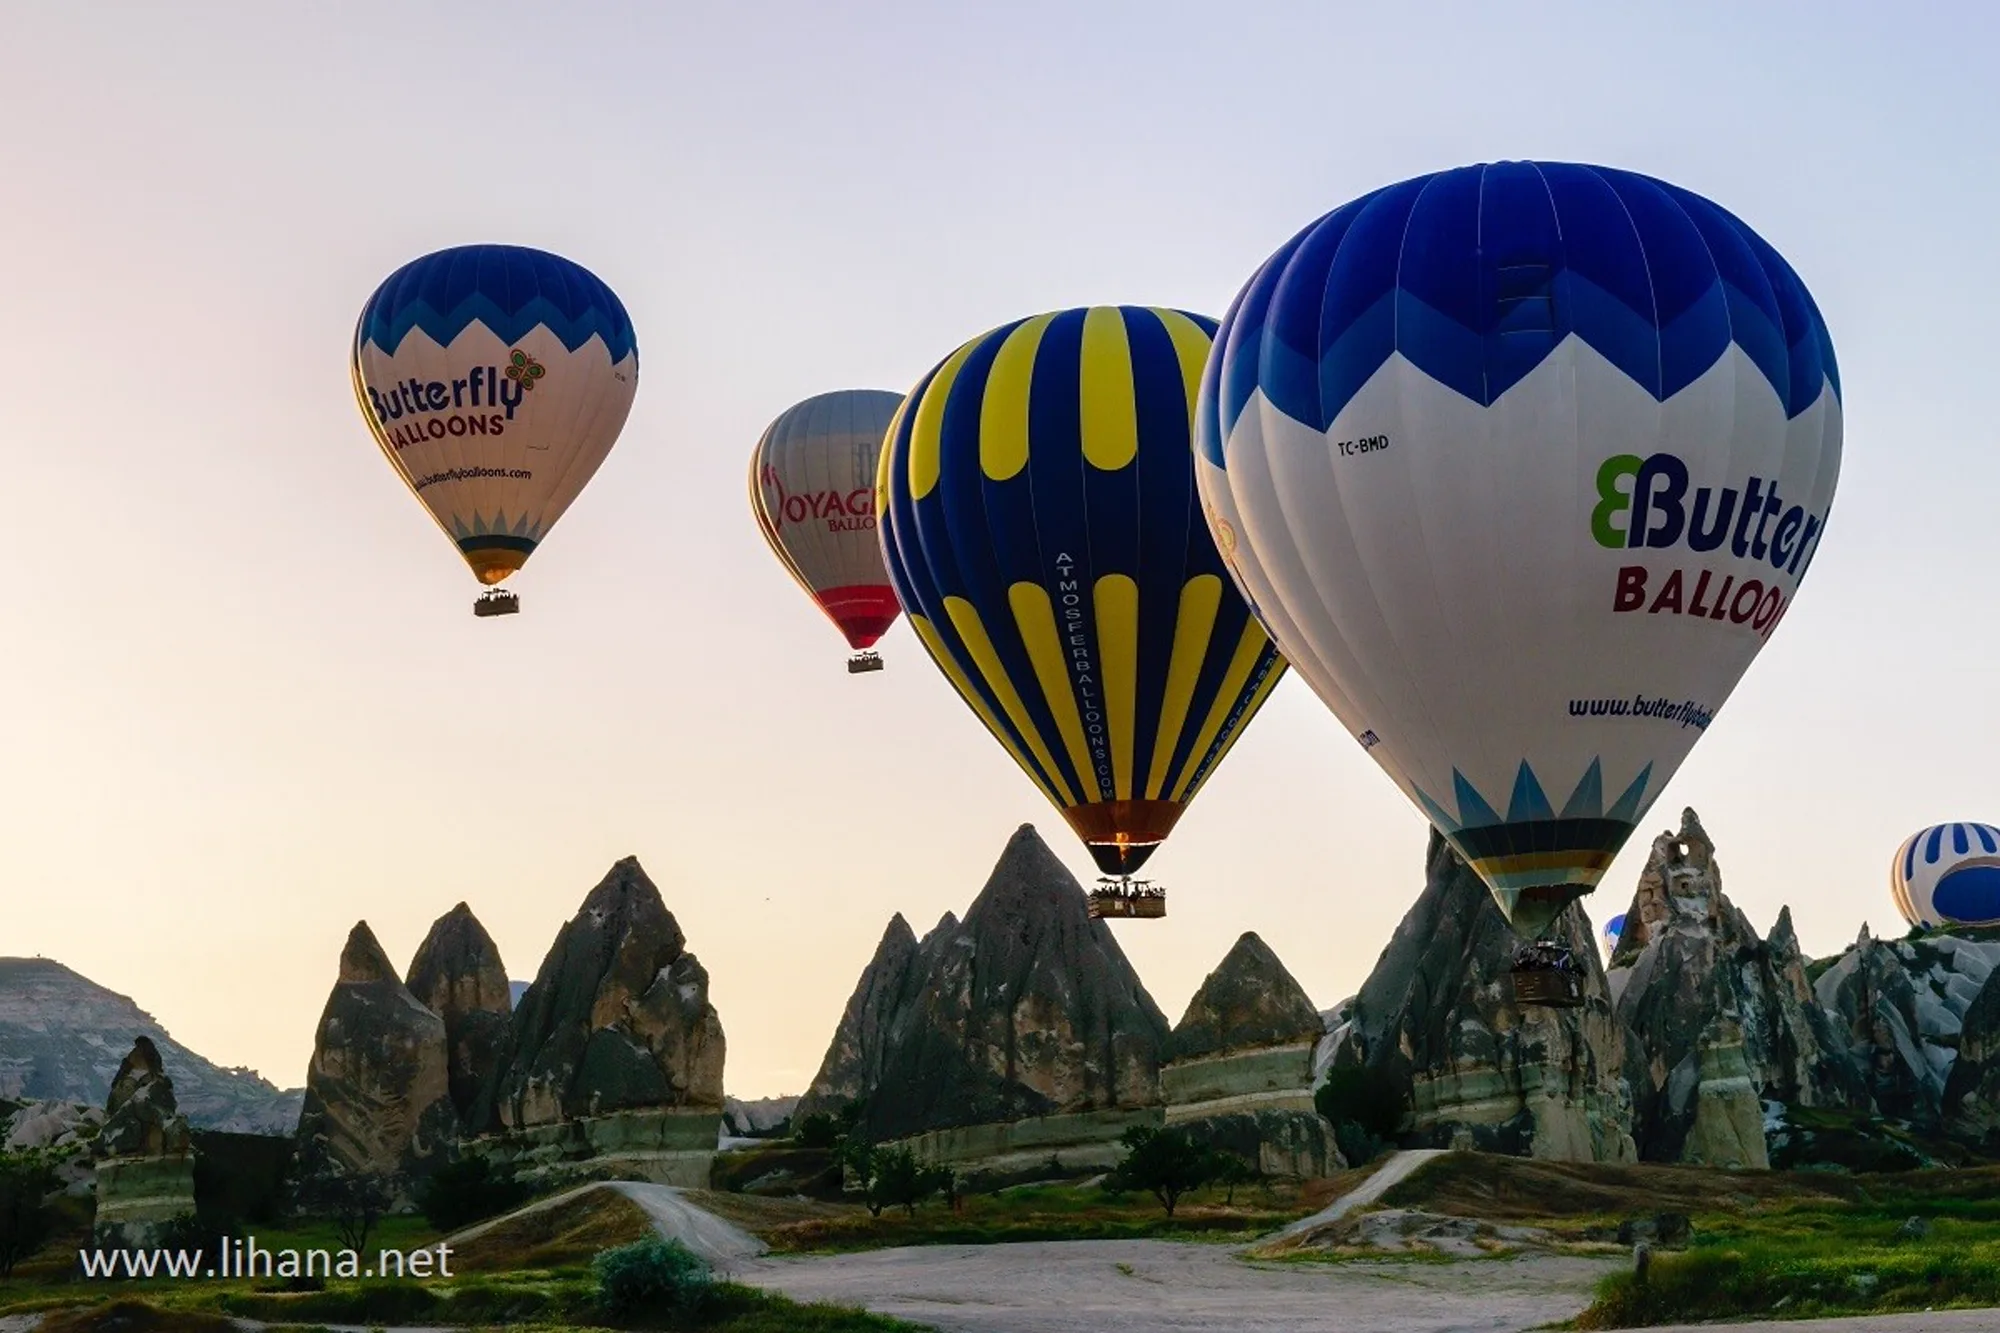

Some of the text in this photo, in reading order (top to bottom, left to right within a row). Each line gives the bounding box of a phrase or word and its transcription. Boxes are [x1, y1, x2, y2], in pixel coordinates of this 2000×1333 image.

[387, 414, 505, 450] ALLOONS
[1338, 435, 1389, 456] TC-BMD
[1628, 453, 1830, 588] Butter
